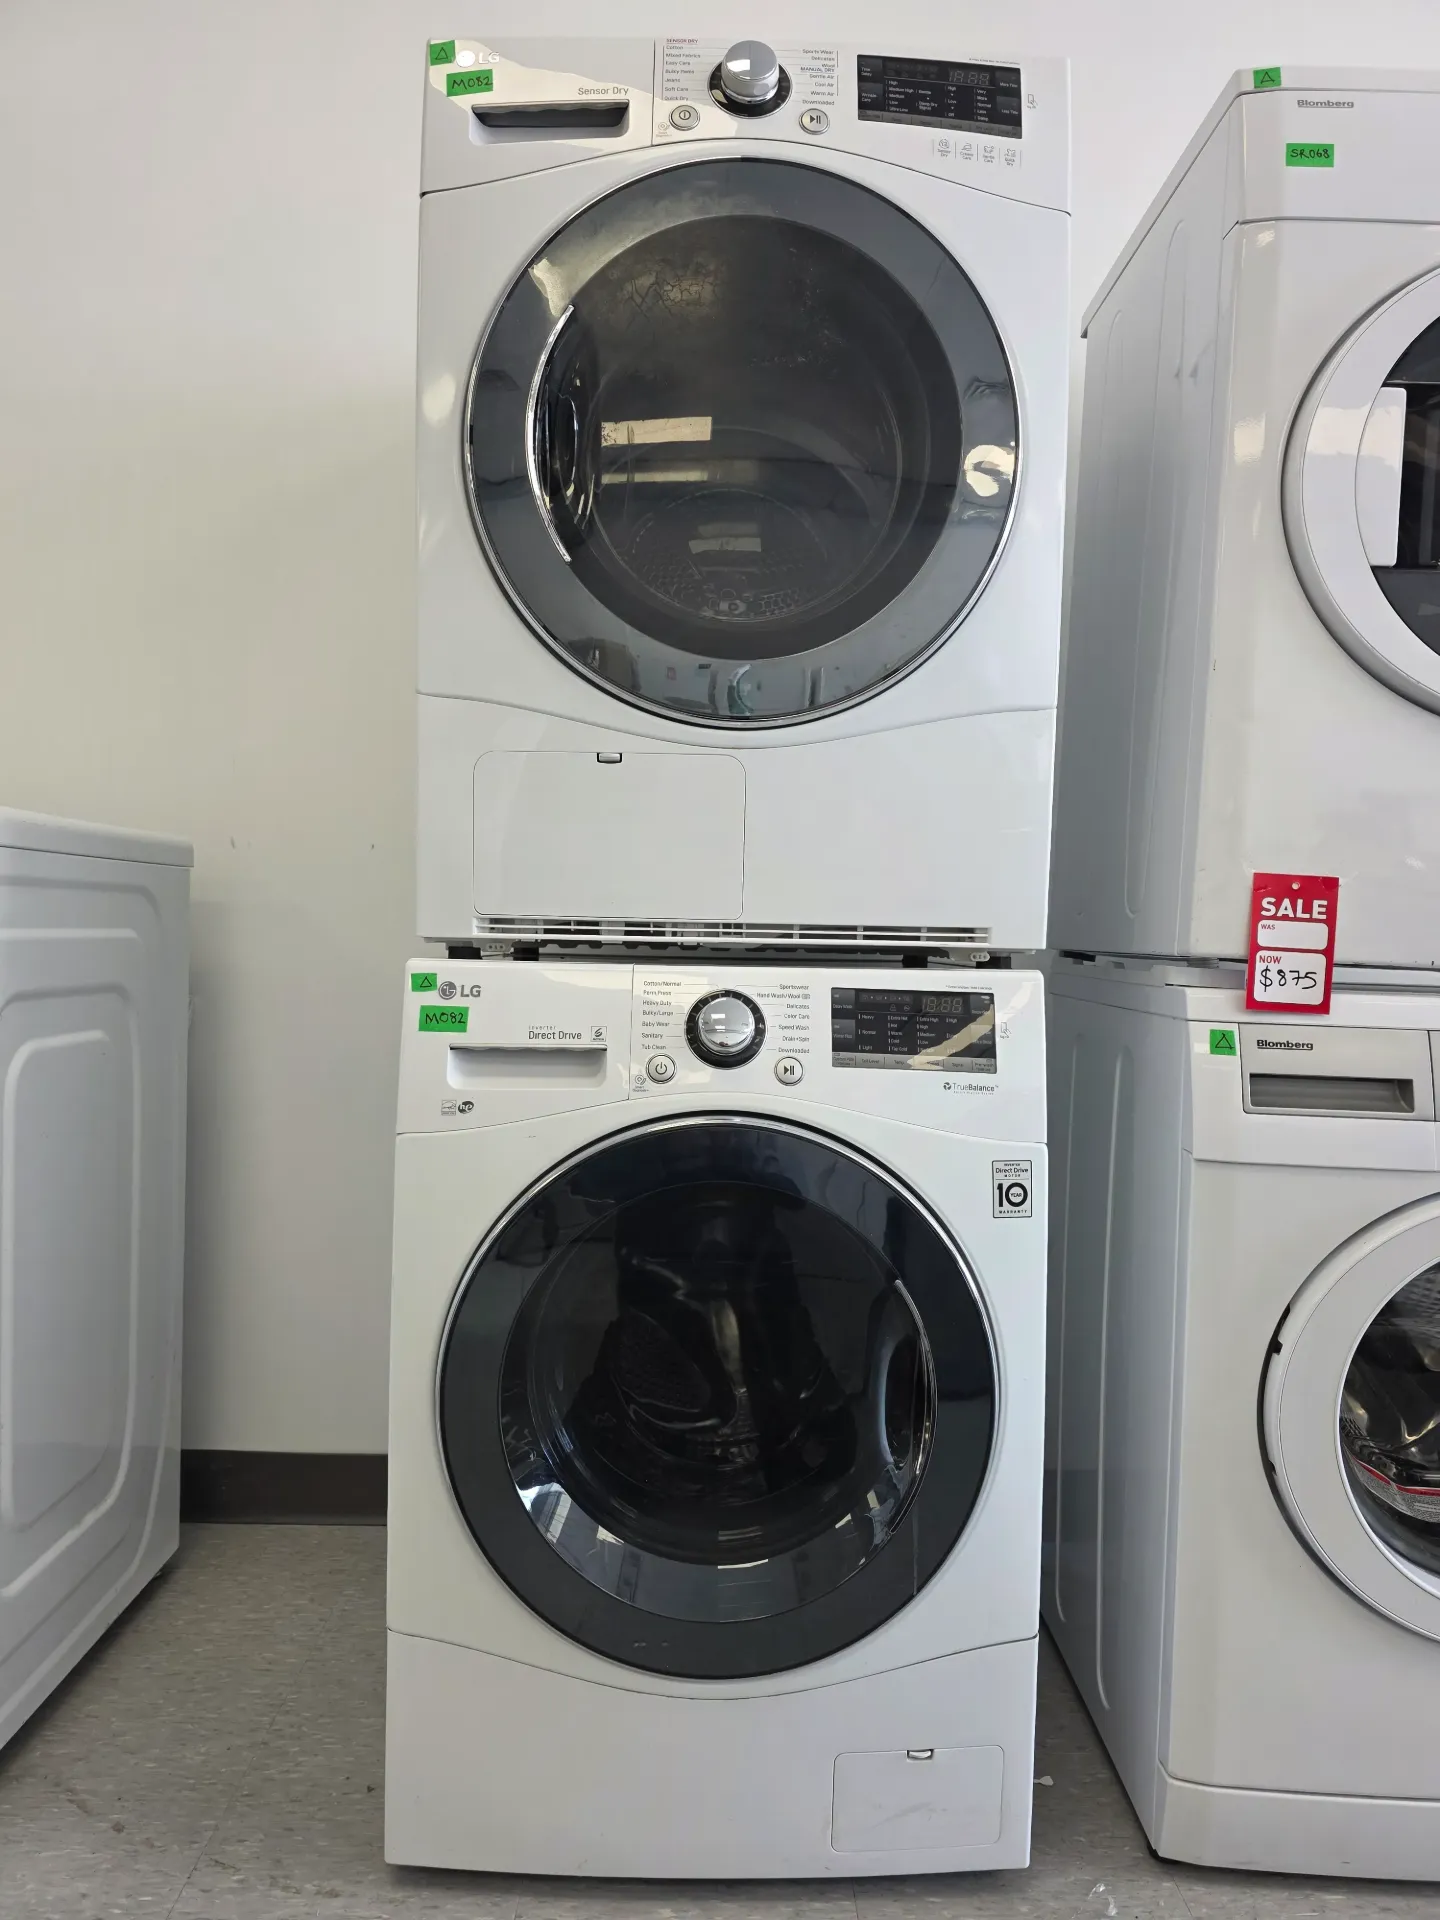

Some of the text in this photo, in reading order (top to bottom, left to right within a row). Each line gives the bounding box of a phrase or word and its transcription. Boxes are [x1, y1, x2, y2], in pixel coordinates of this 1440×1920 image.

[478, 52, 500, 64] LG
[452, 76, 493, 90] M082
[578, 86, 629, 96] Sensor Dry
[1297, 100, 1354, 108] Blomberg
[1290, 149, 1330, 159] SR068
[1260, 897, 1328, 920] SALE
[1259, 955, 1282, 964] NOW
[1259, 965, 1317, 992] $875
[460, 985, 481, 998] LG
[425, 1012, 466, 1024] M082
[528, 1031, 556, 1040] Direct
[558, 1031, 582, 1040] Drive
[1256, 1039, 1313, 1050] Blomberg
[997, 1182, 1028, 1207] 10
